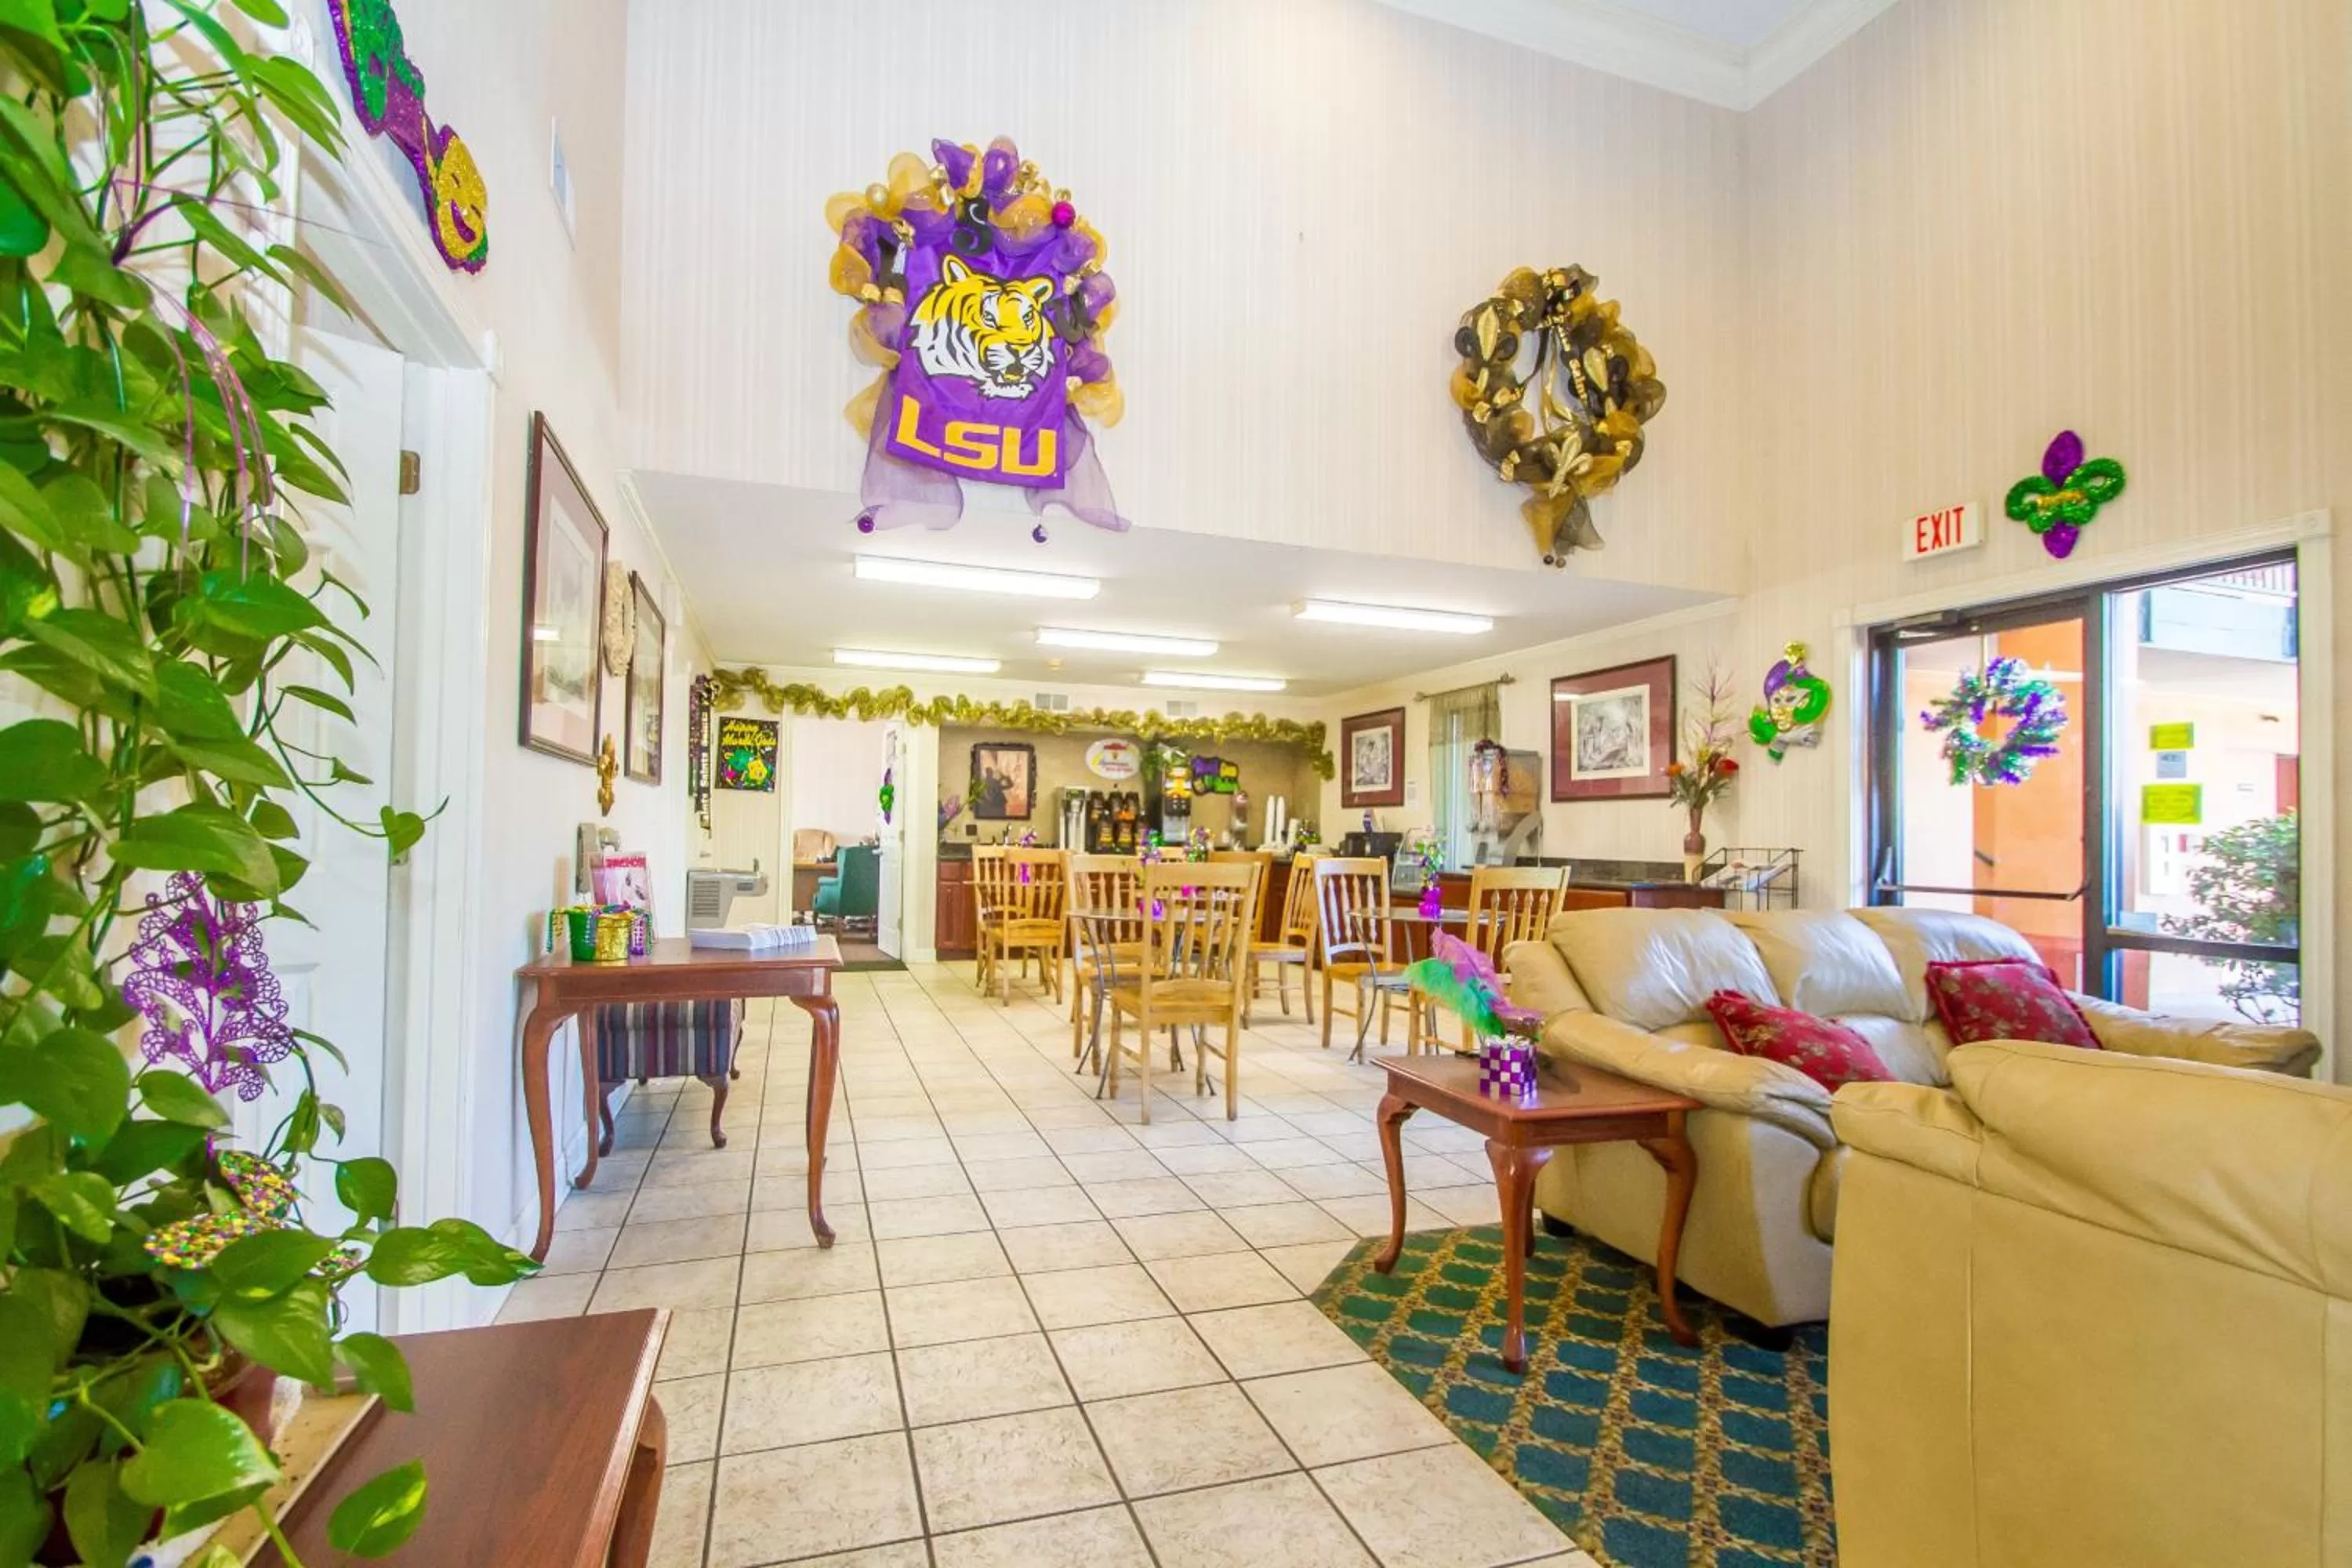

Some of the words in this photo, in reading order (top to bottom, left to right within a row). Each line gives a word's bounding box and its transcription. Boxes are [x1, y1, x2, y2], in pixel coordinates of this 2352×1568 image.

[896, 395, 1057, 477] LSU
[1917, 506, 1964, 554] EXIT
[699, 752, 710, 788] Saints
